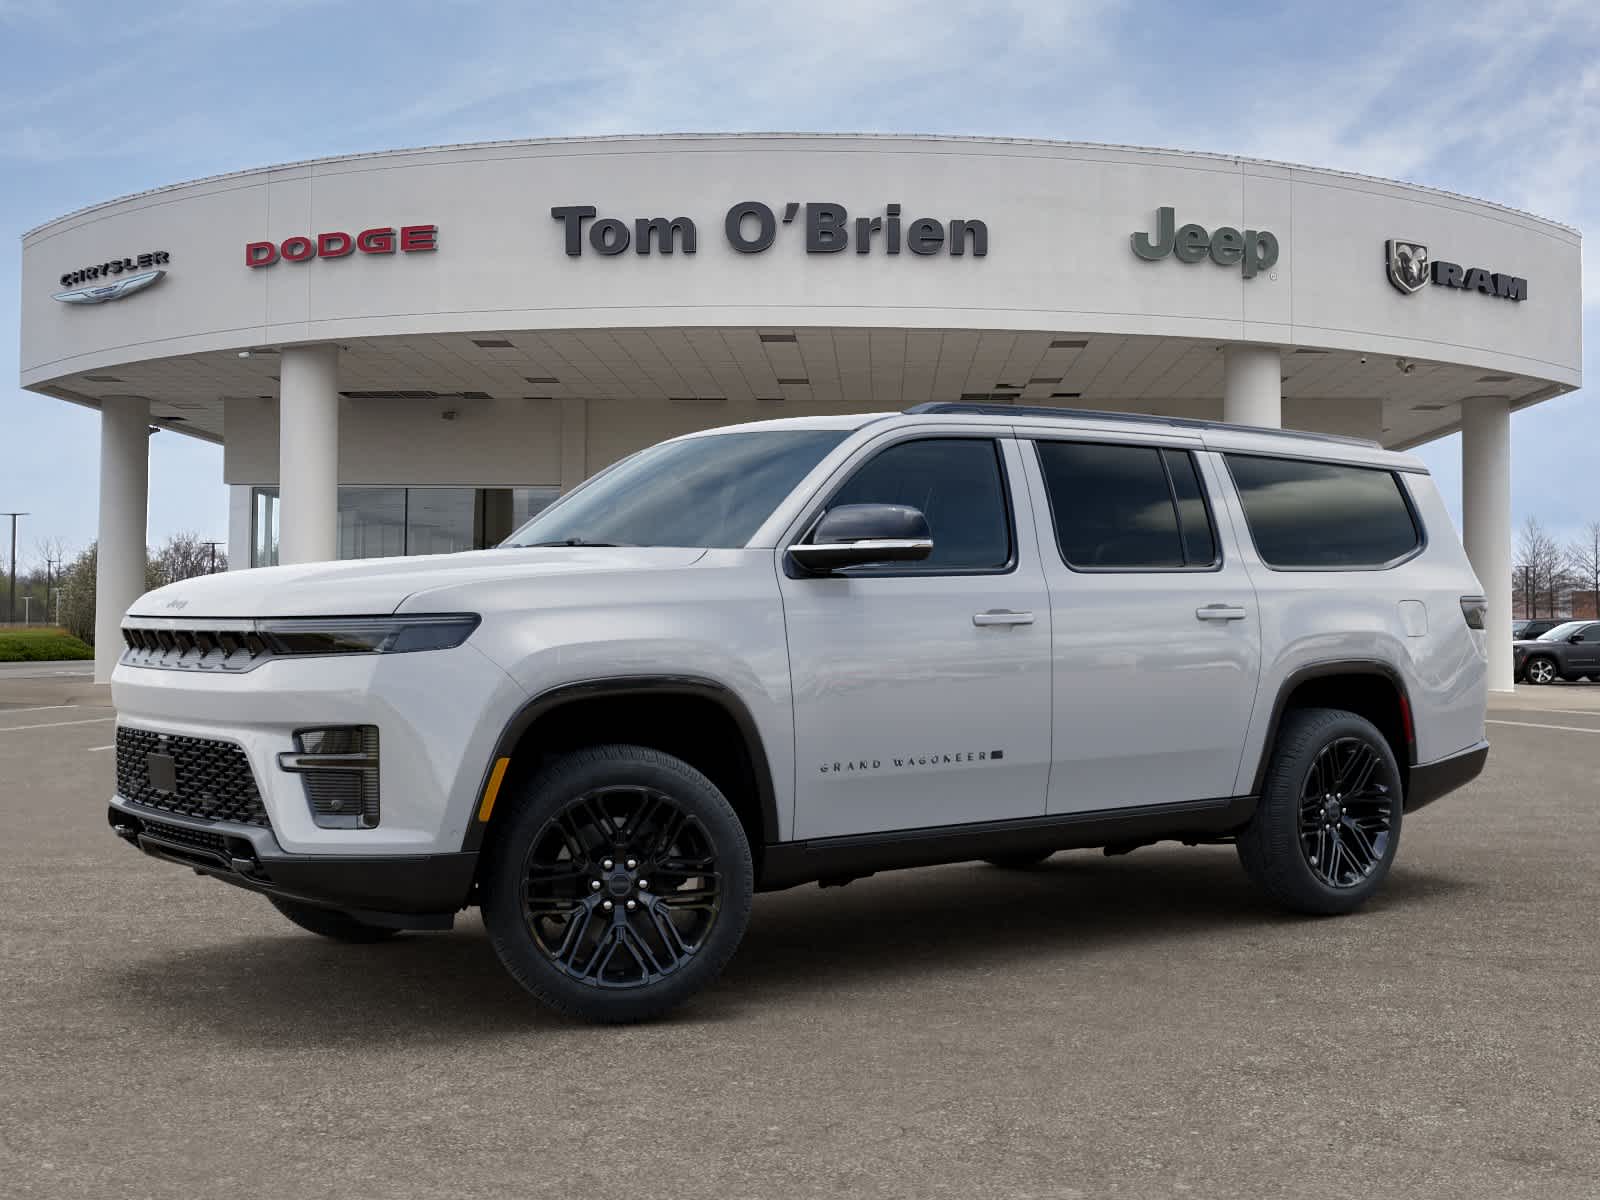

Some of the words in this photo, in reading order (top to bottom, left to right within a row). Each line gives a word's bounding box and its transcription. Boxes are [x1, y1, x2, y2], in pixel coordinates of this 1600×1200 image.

[246, 224, 438, 269] DODGE
[551, 205, 697, 256] Tom
[725, 201, 988, 257] O'Brien
[1131, 206, 1279, 279] Jeep
[60, 250, 169, 287] CHRYSLER
[1431, 260, 1528, 302] RAM
[820, 759, 881, 773] GRAND
[893, 751, 986, 767] WAGONEER
